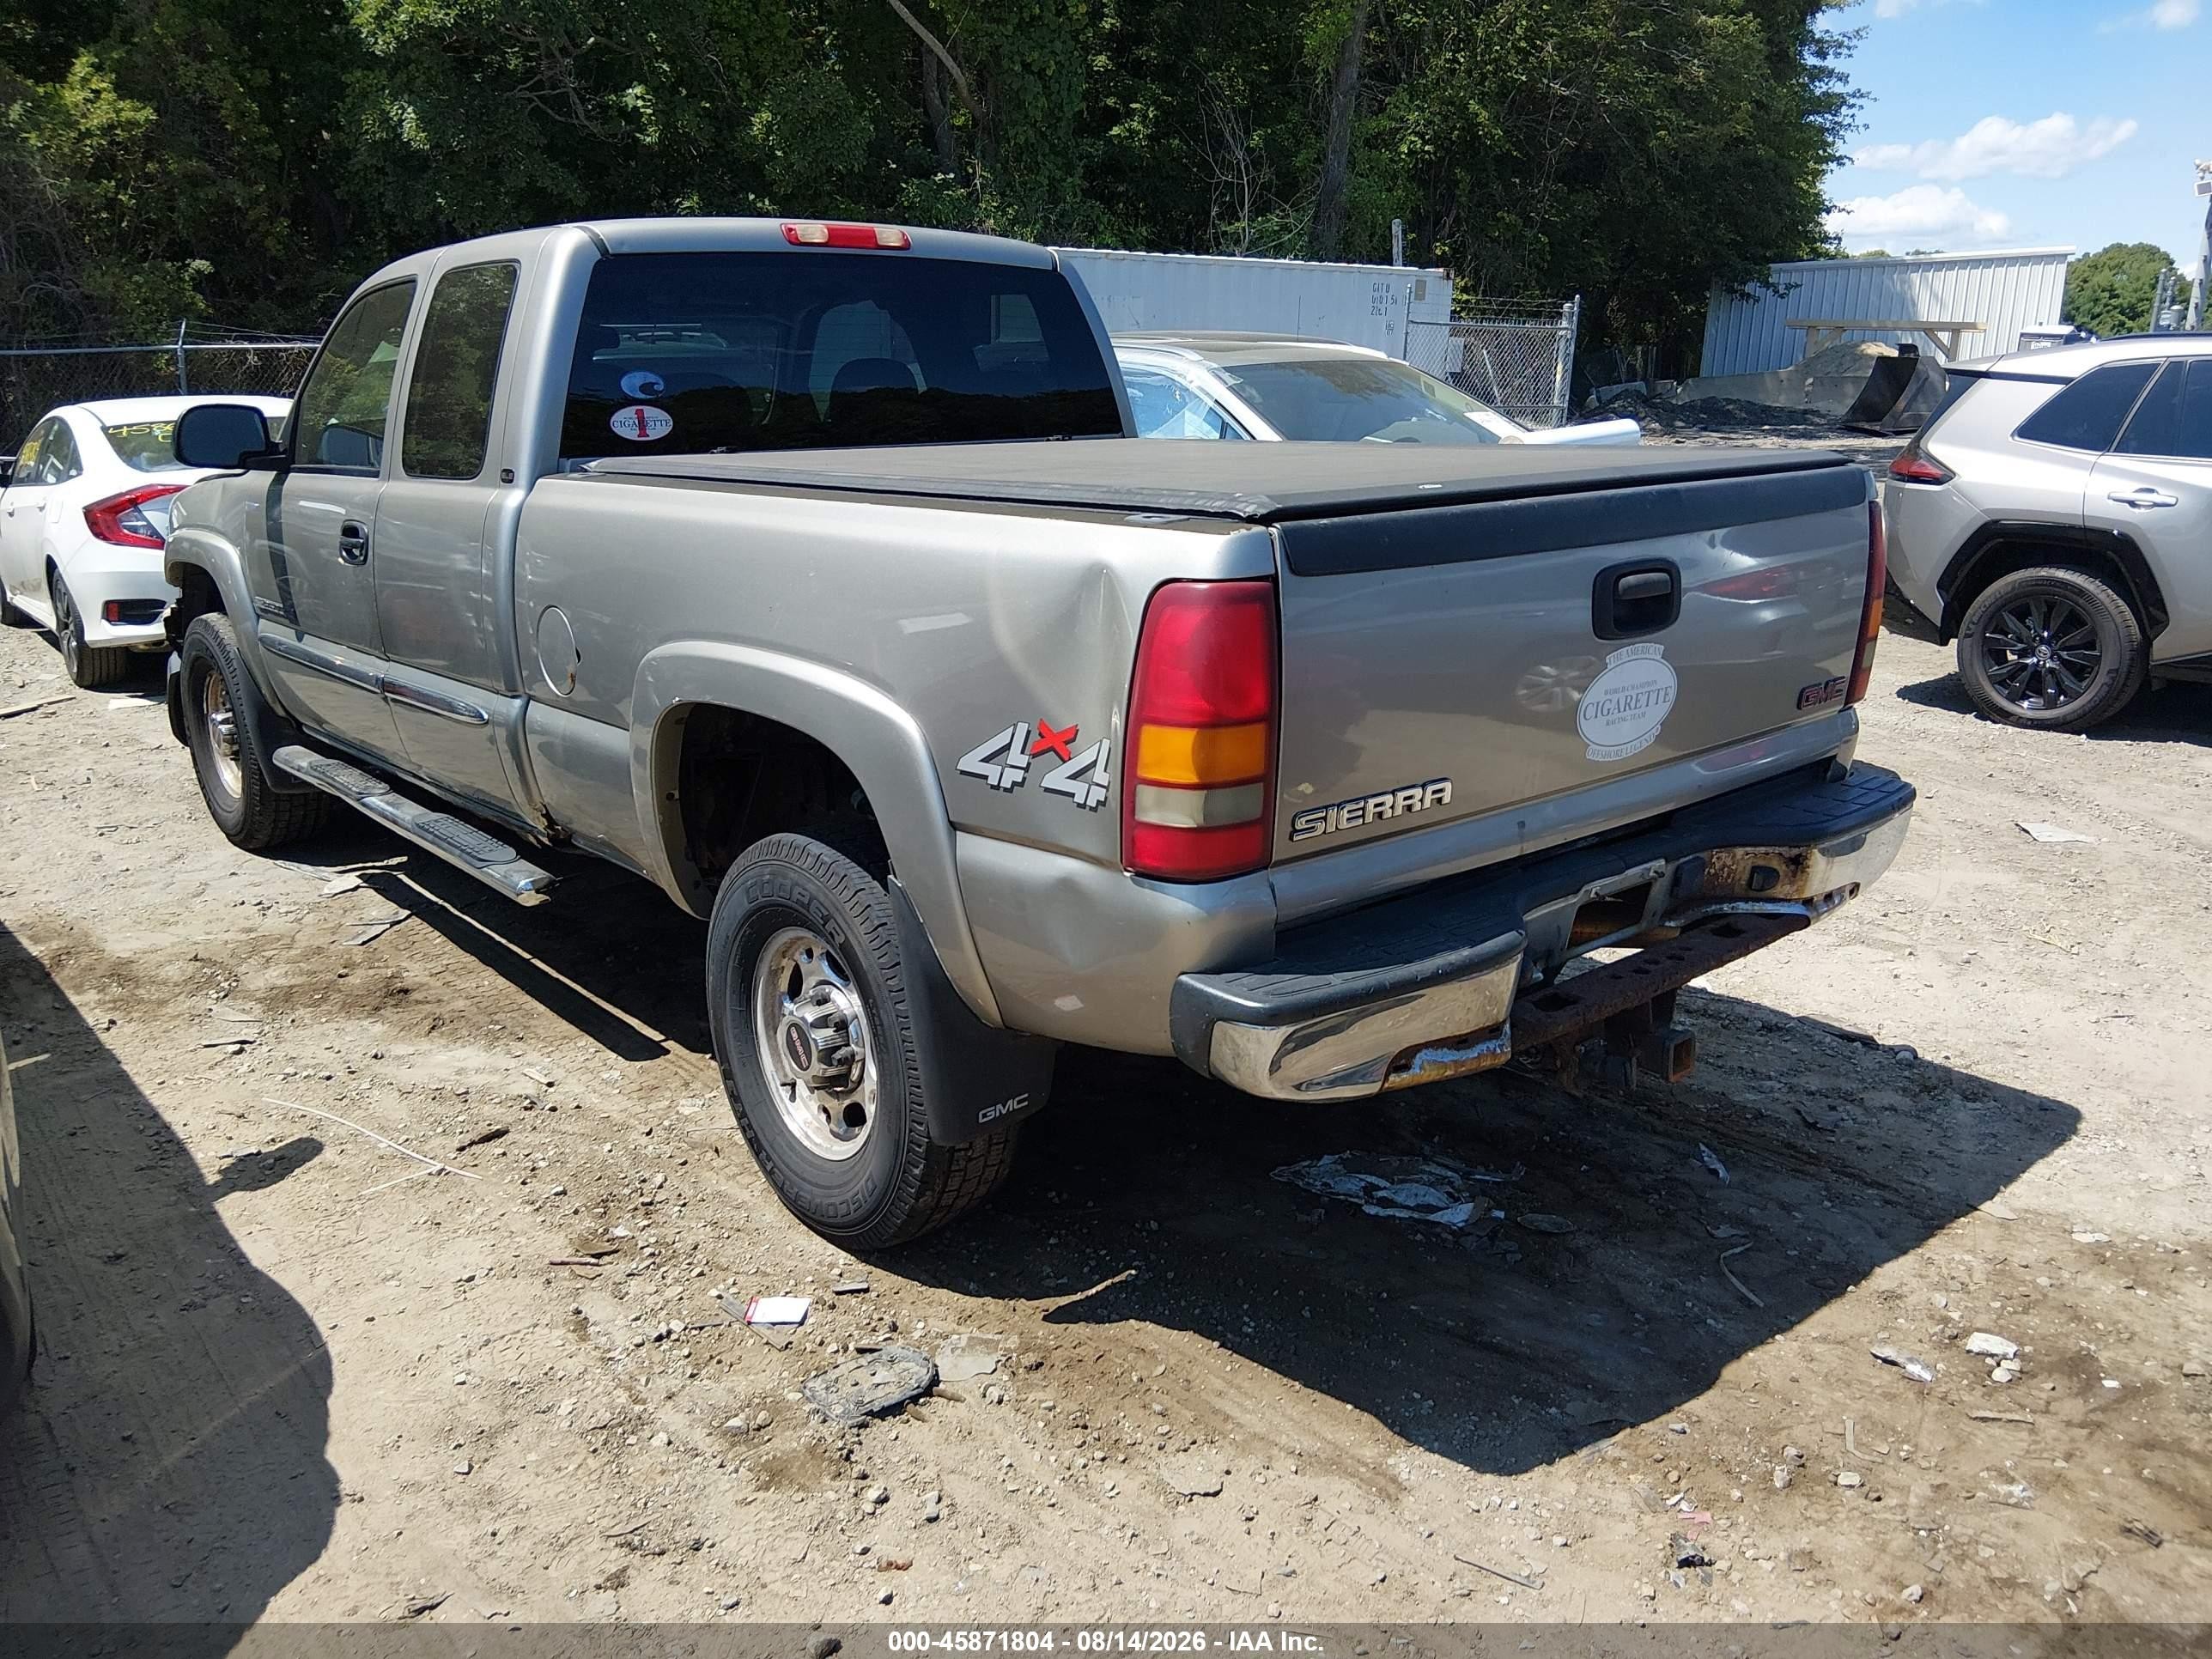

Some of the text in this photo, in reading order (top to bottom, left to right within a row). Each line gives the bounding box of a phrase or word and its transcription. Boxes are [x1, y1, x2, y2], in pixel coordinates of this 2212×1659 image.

[612, 419, 672, 428] CIGAETTE
[635, 408, 650, 438] 1
[1607, 644, 1663, 665] THE AMERICAN
[1583, 685, 1673, 721] CIGARETTE
[1796, 675, 1846, 710] GMC
[1630, 710, 1647, 722] TEAM
[1588, 747, 1625, 760] OFFSHORE
[1289, 777, 1452, 842] SIERRA
[747, 878, 846, 947] COOPER
[790, 1026, 809, 1068] GMC
[978, 1092, 1029, 1124] GMC
